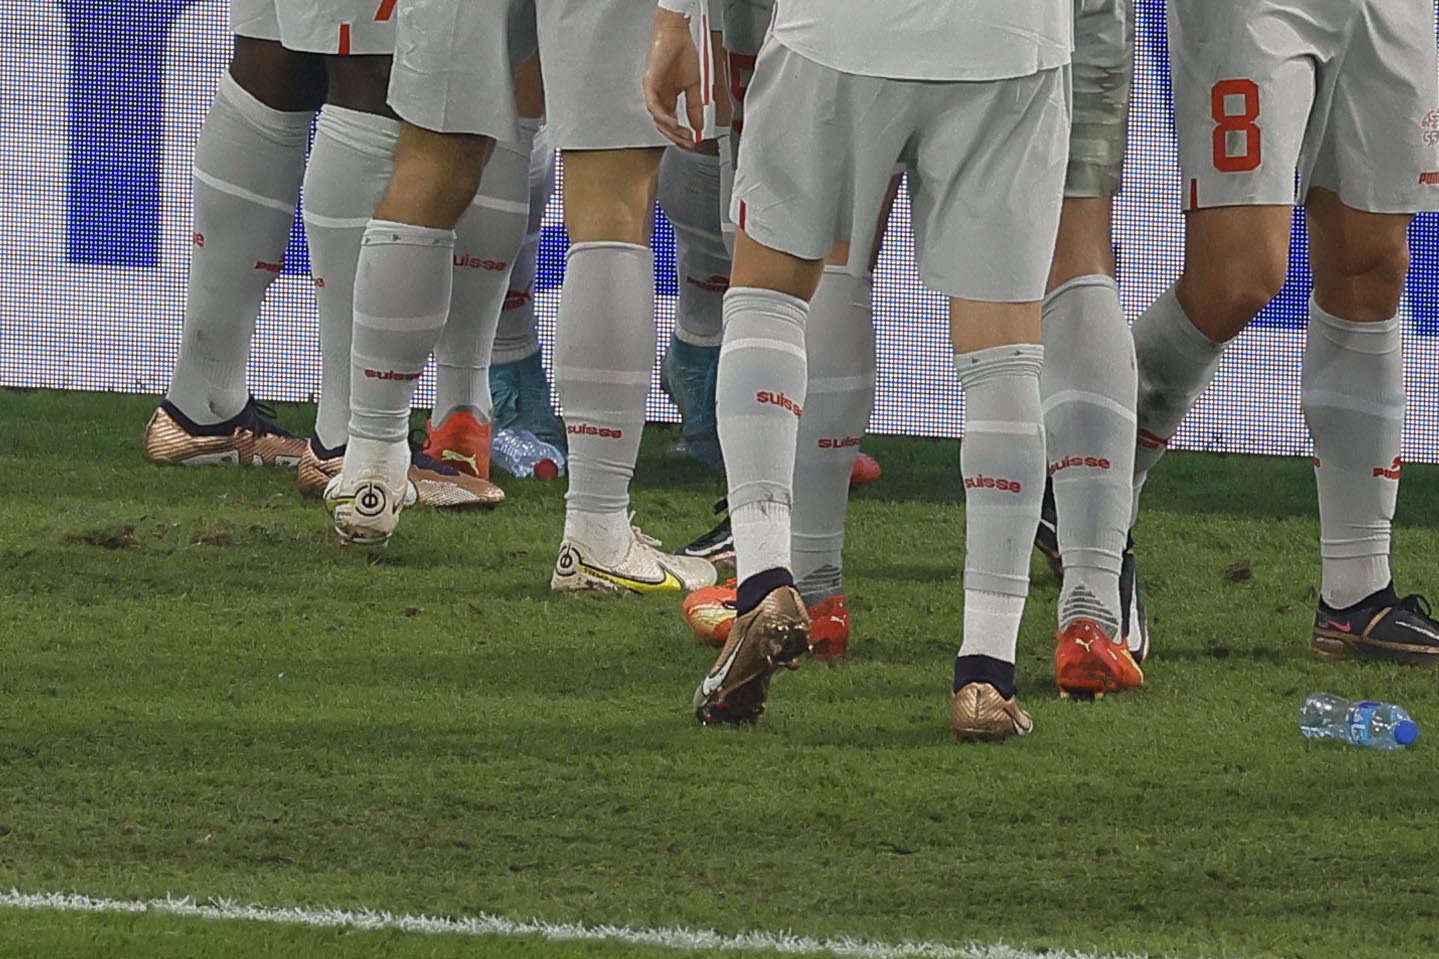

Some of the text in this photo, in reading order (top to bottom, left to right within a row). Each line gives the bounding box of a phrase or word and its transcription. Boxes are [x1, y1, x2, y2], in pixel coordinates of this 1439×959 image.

[1210, 79, 1261, 172] 8
[453, 254, 506, 271] uisse
[964, 474, 1021, 493] suisse
